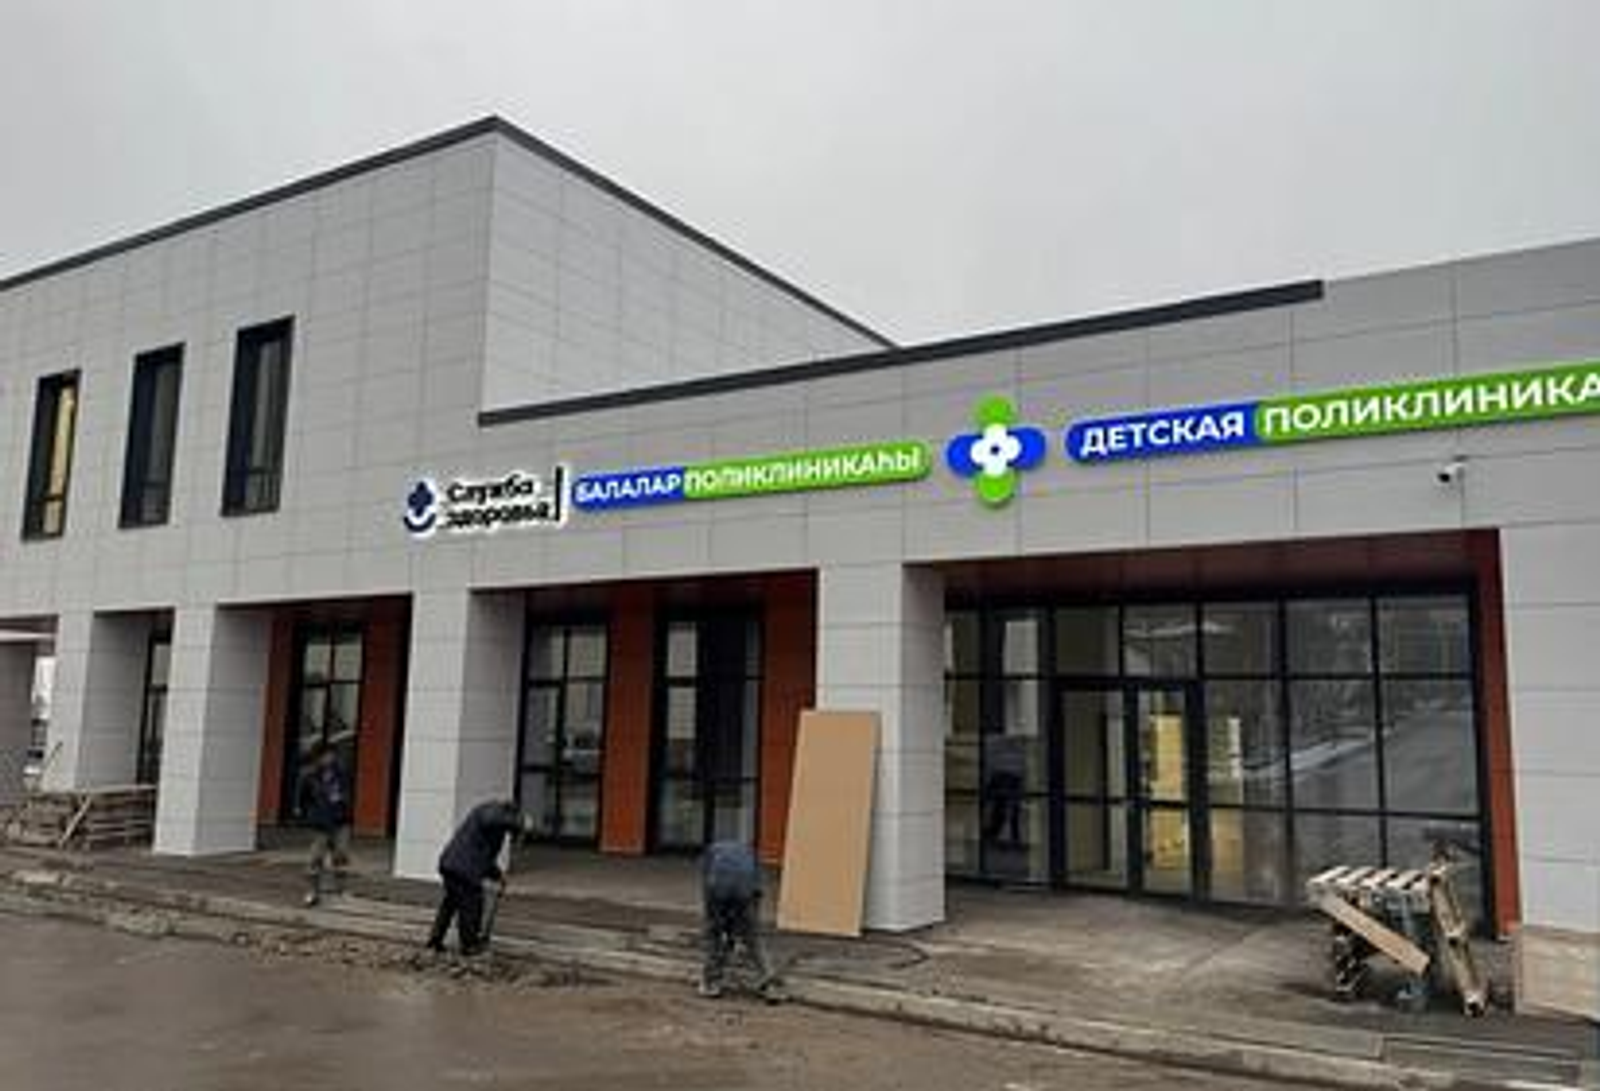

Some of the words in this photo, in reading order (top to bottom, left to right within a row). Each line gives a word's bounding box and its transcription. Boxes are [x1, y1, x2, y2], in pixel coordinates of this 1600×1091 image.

[1079, 411, 1244, 457] ДЕТСКАЯ
[1265, 372, 1600, 436] ПОЛИКЛИНИКА
[446, 474, 534, 505] Служба
[575, 473, 682, 503] БАЛАЛАР
